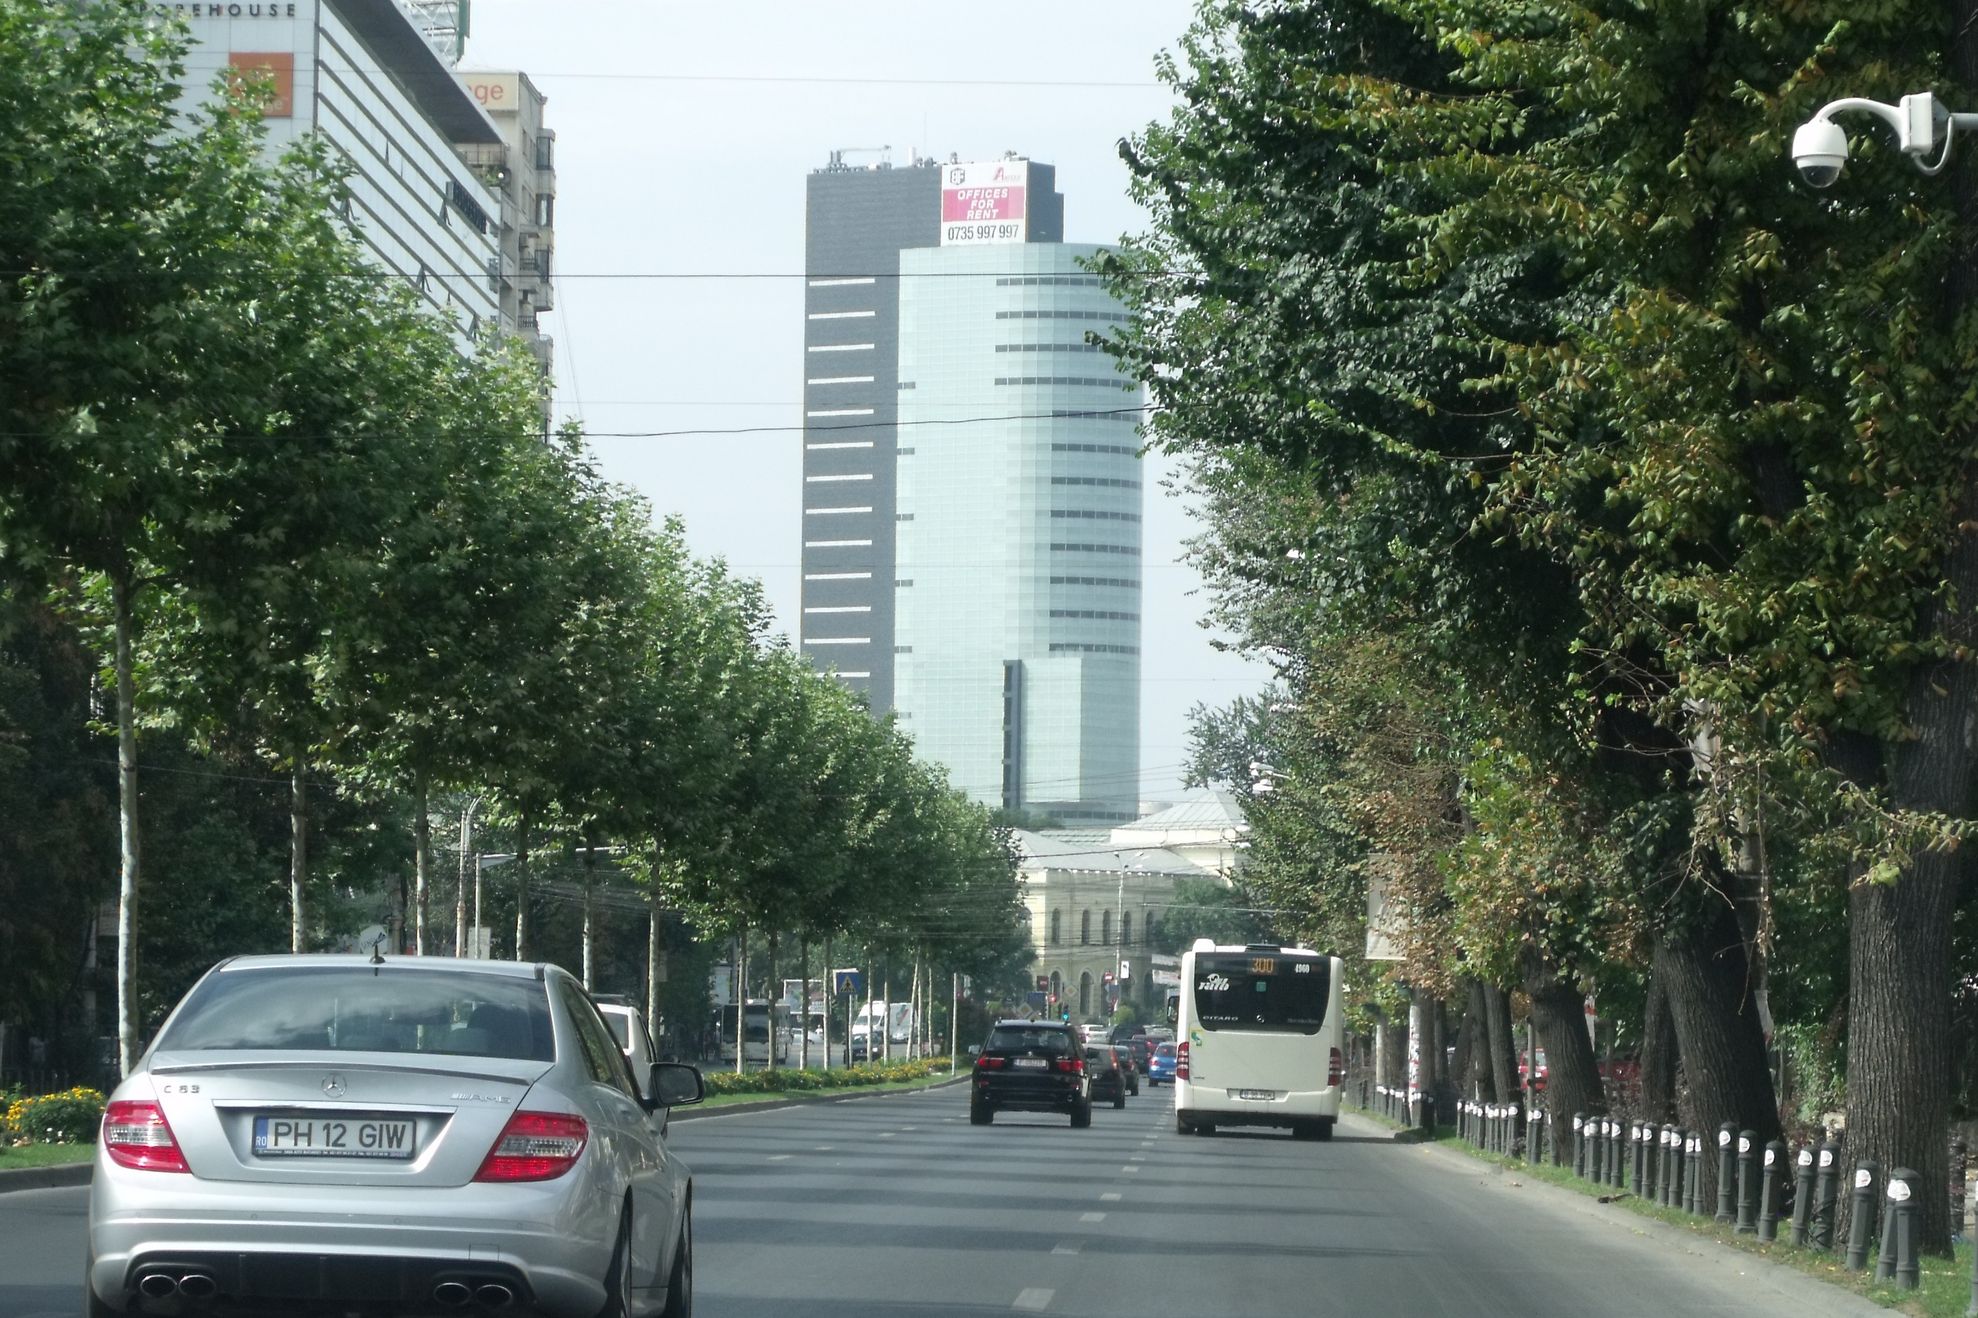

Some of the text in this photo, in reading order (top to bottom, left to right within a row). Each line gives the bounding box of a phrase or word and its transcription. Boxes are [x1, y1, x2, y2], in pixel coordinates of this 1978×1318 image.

[957, 188, 1008, 200] OFFICES
[970, 198, 995, 210] FOR
[966, 209, 999, 220] RENT
[947, 224, 1019, 241] 0735 997 997
[1251, 957, 1274, 973] 300
[255, 1135, 267, 1146] RO
[273, 1121, 407, 1149] PH 12 GIW
